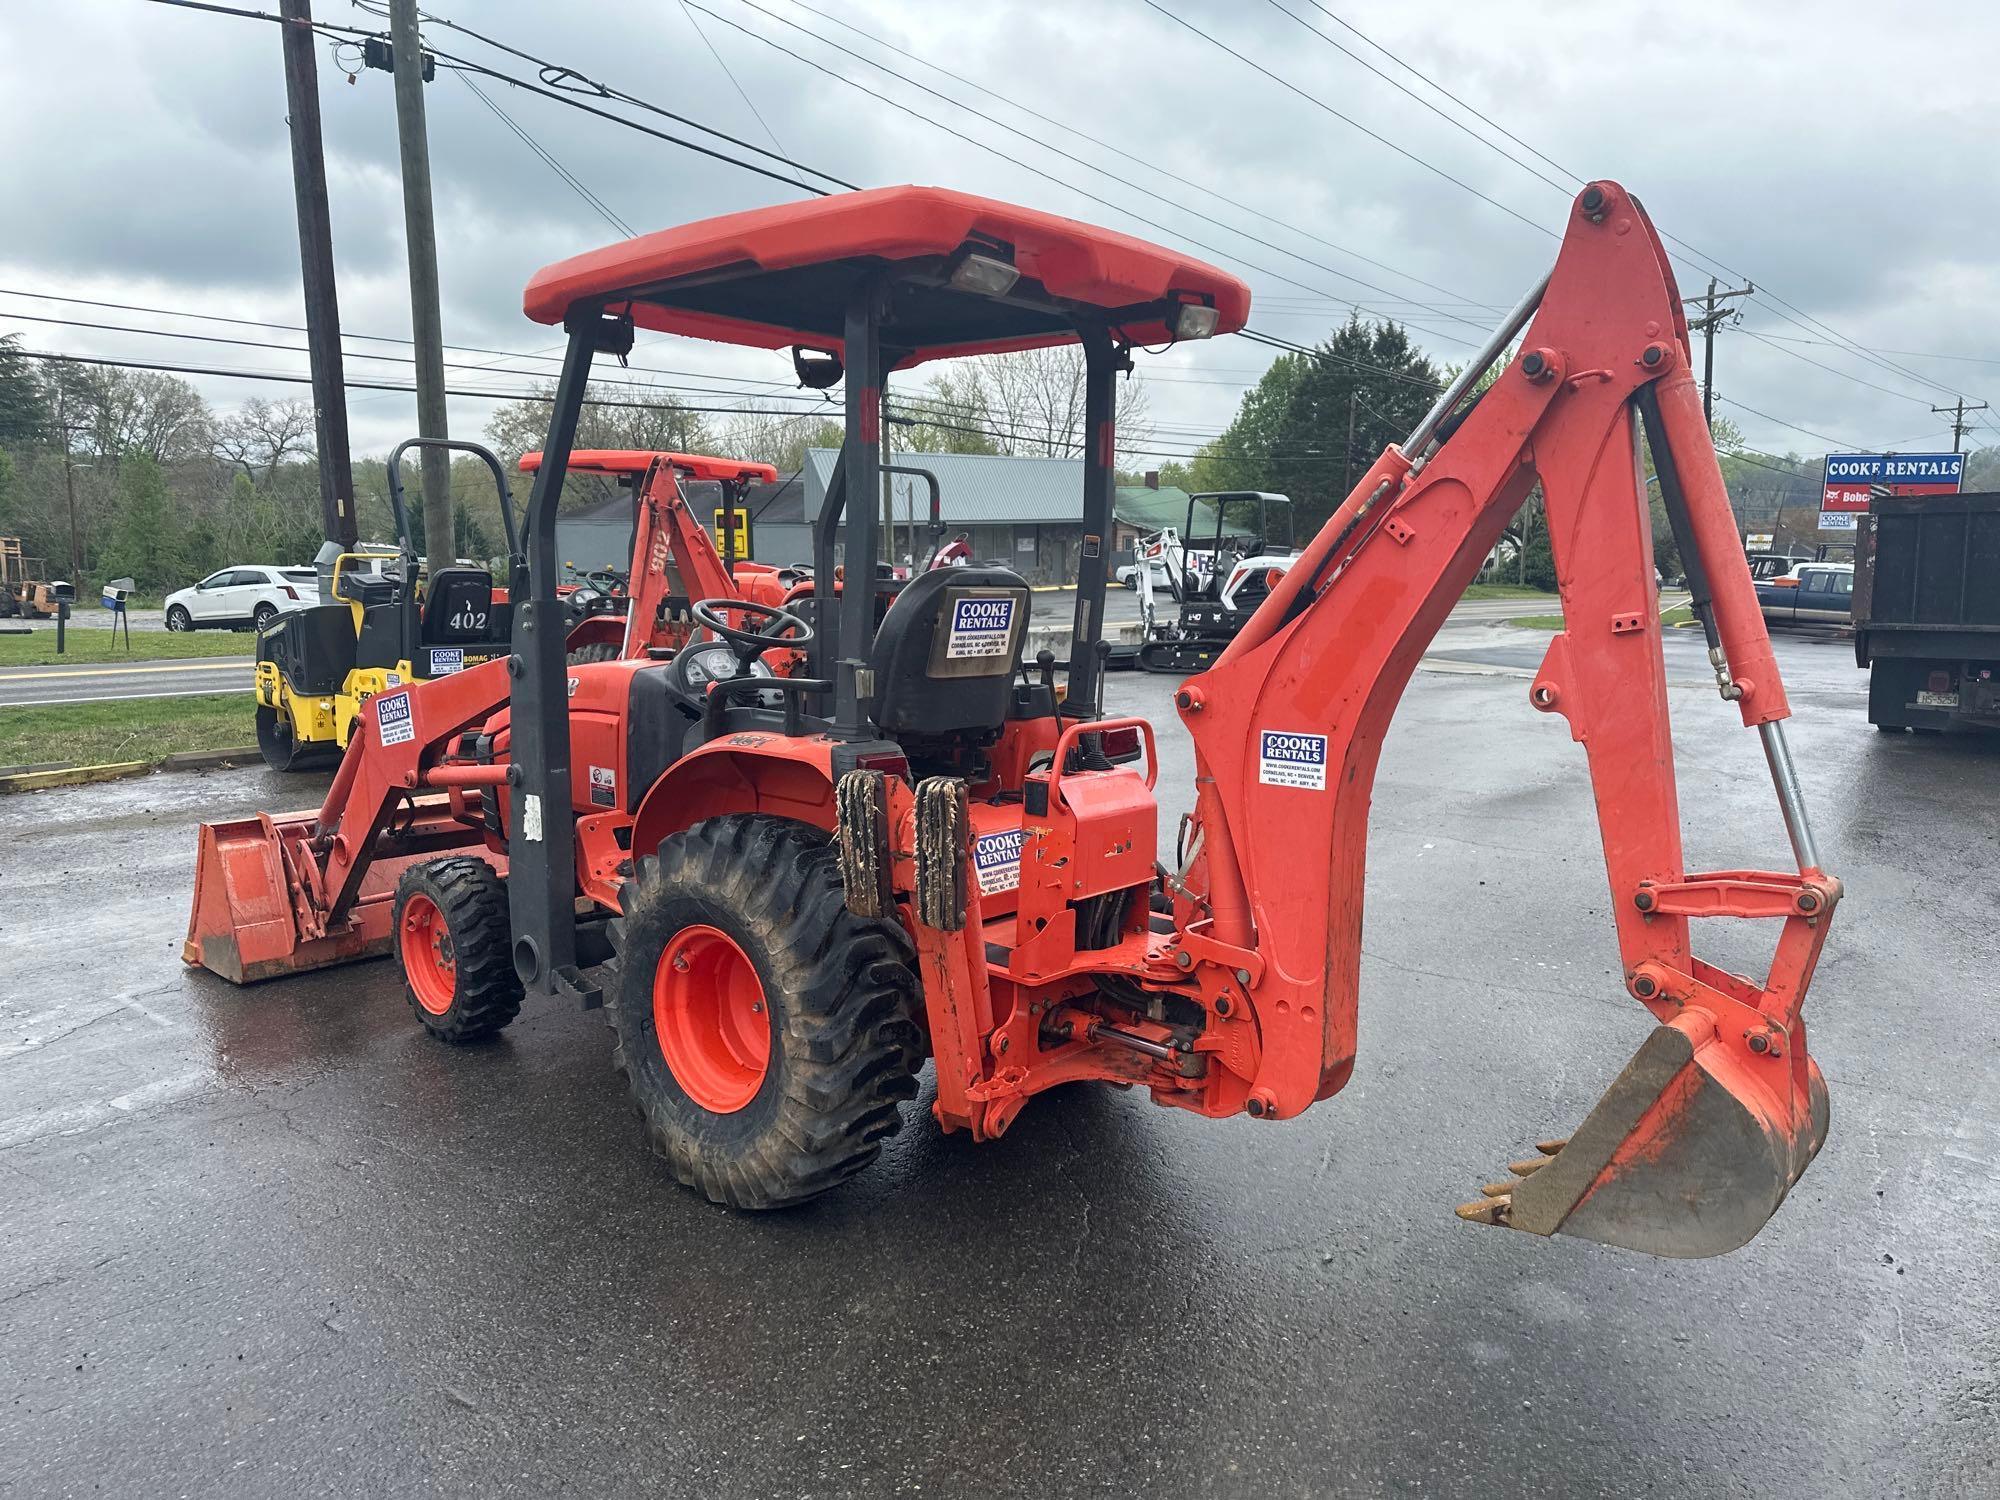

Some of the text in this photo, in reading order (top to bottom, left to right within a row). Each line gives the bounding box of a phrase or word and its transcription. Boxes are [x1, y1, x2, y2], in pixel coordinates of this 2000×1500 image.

[1829, 462, 1960, 475] COOKE RENTALS
[961, 603, 1008, 617] COOKE
[450, 612, 487, 629] 402
[959, 617, 1006, 629] RENTALS
[380, 697, 407, 713] COOKE
[382, 708, 408, 723] RENTALS
[1267, 736, 1321, 752] COOKE
[1267, 748, 1321, 762] RENTALS
[977, 833, 1021, 854] COOKE
